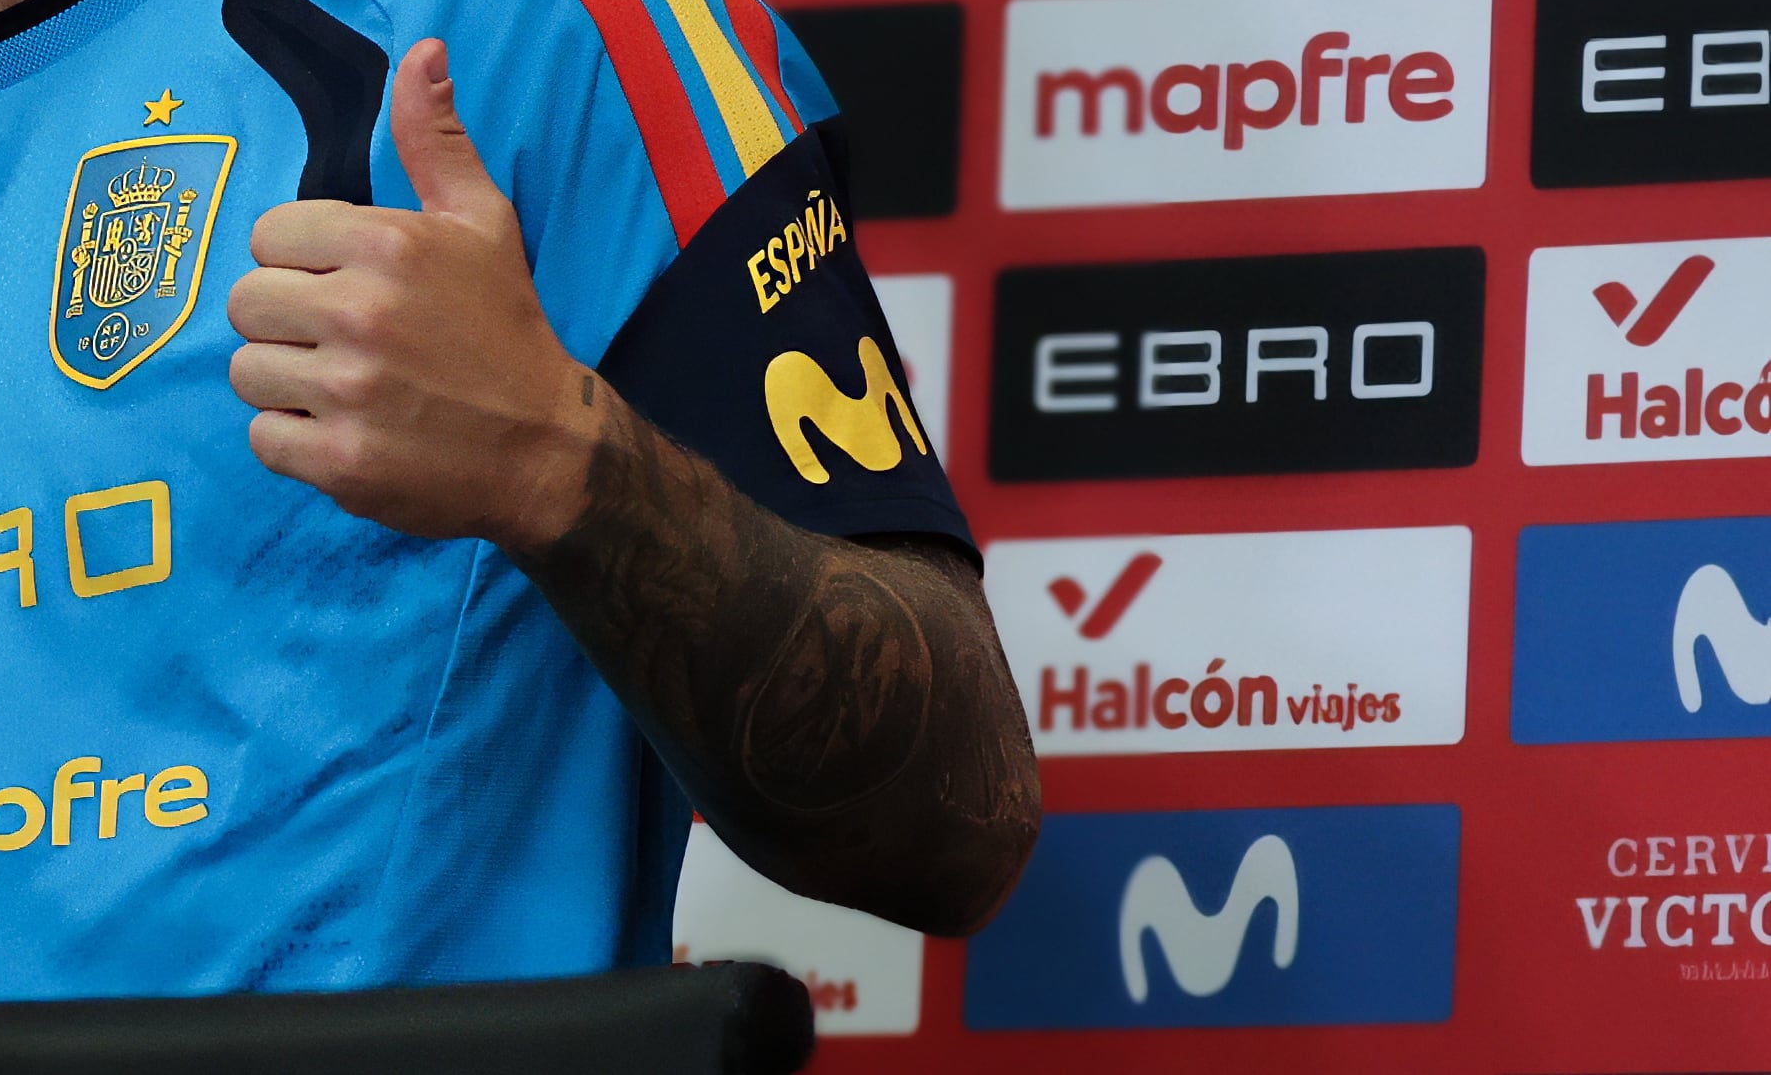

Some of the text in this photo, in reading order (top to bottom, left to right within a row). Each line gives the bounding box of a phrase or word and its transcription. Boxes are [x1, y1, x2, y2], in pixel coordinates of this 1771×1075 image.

[1034, 31, 1455, 151] mapfre
[1033, 321, 1435, 413] EBRO
[1037, 658, 1401, 733] Halcón viajes
[1607, 834, 1771, 877] CERV
